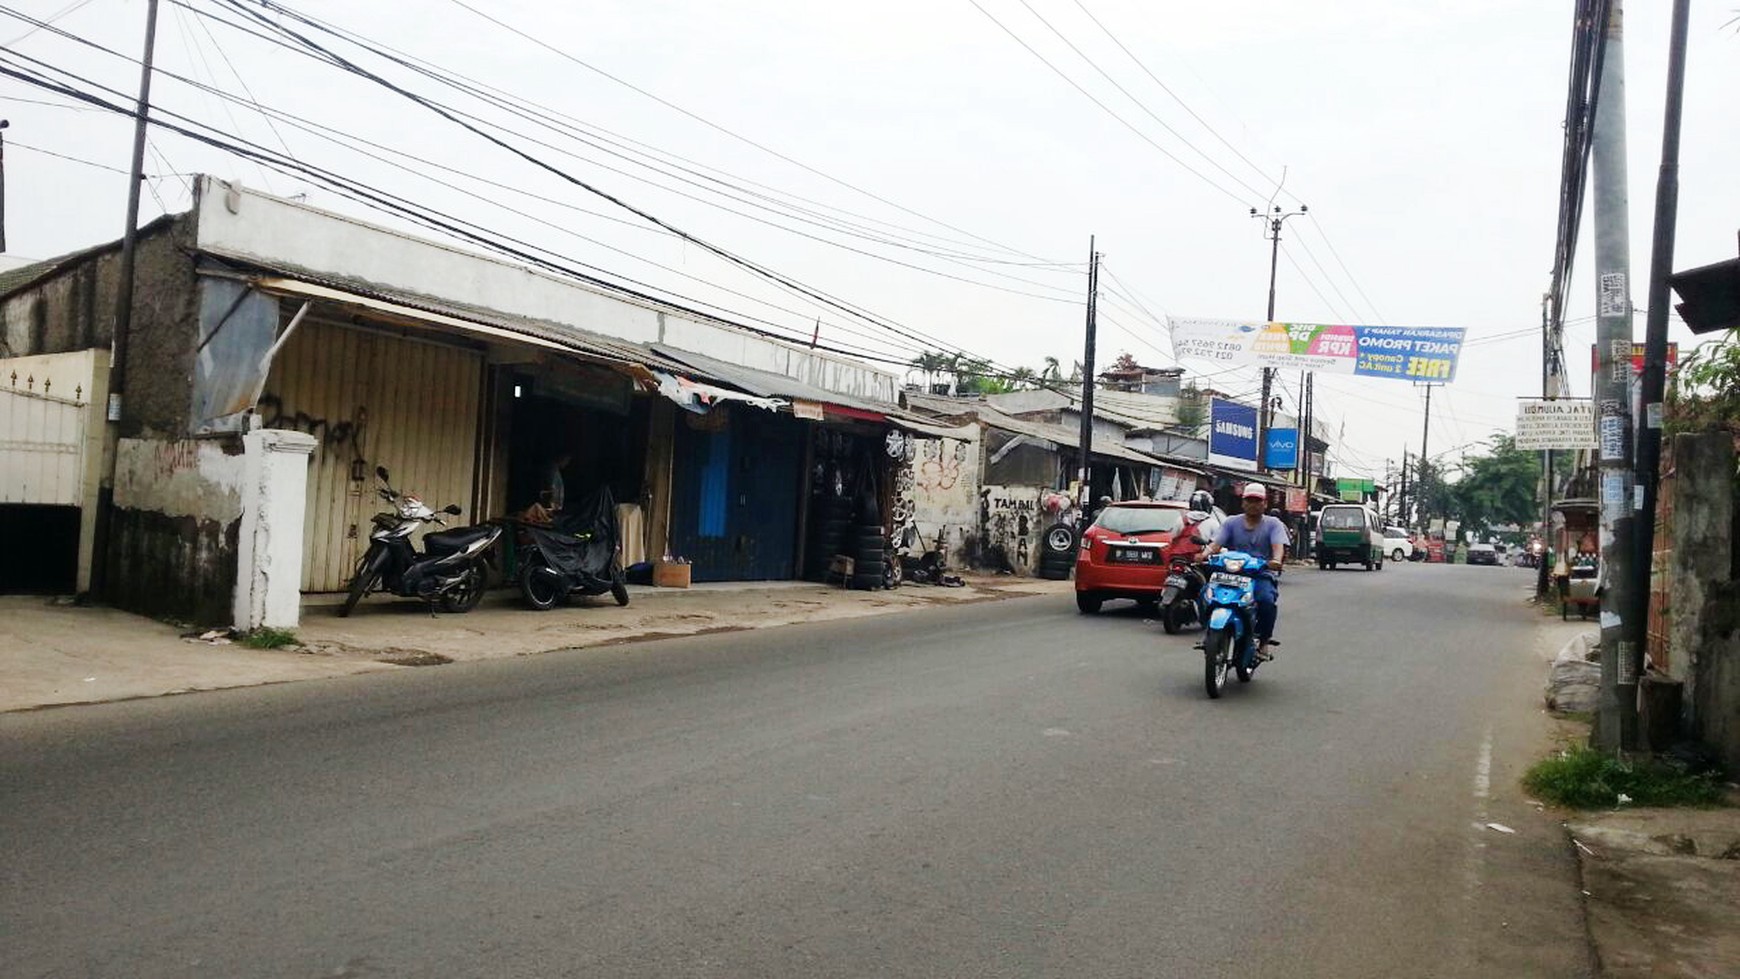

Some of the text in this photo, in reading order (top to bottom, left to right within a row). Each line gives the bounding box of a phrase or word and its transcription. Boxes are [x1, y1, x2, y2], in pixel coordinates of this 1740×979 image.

[1215, 420, 1253, 439] SAMSUNG
[994, 498, 1035, 511] TAMBAL
[1017, 515, 1030, 566] BAN
